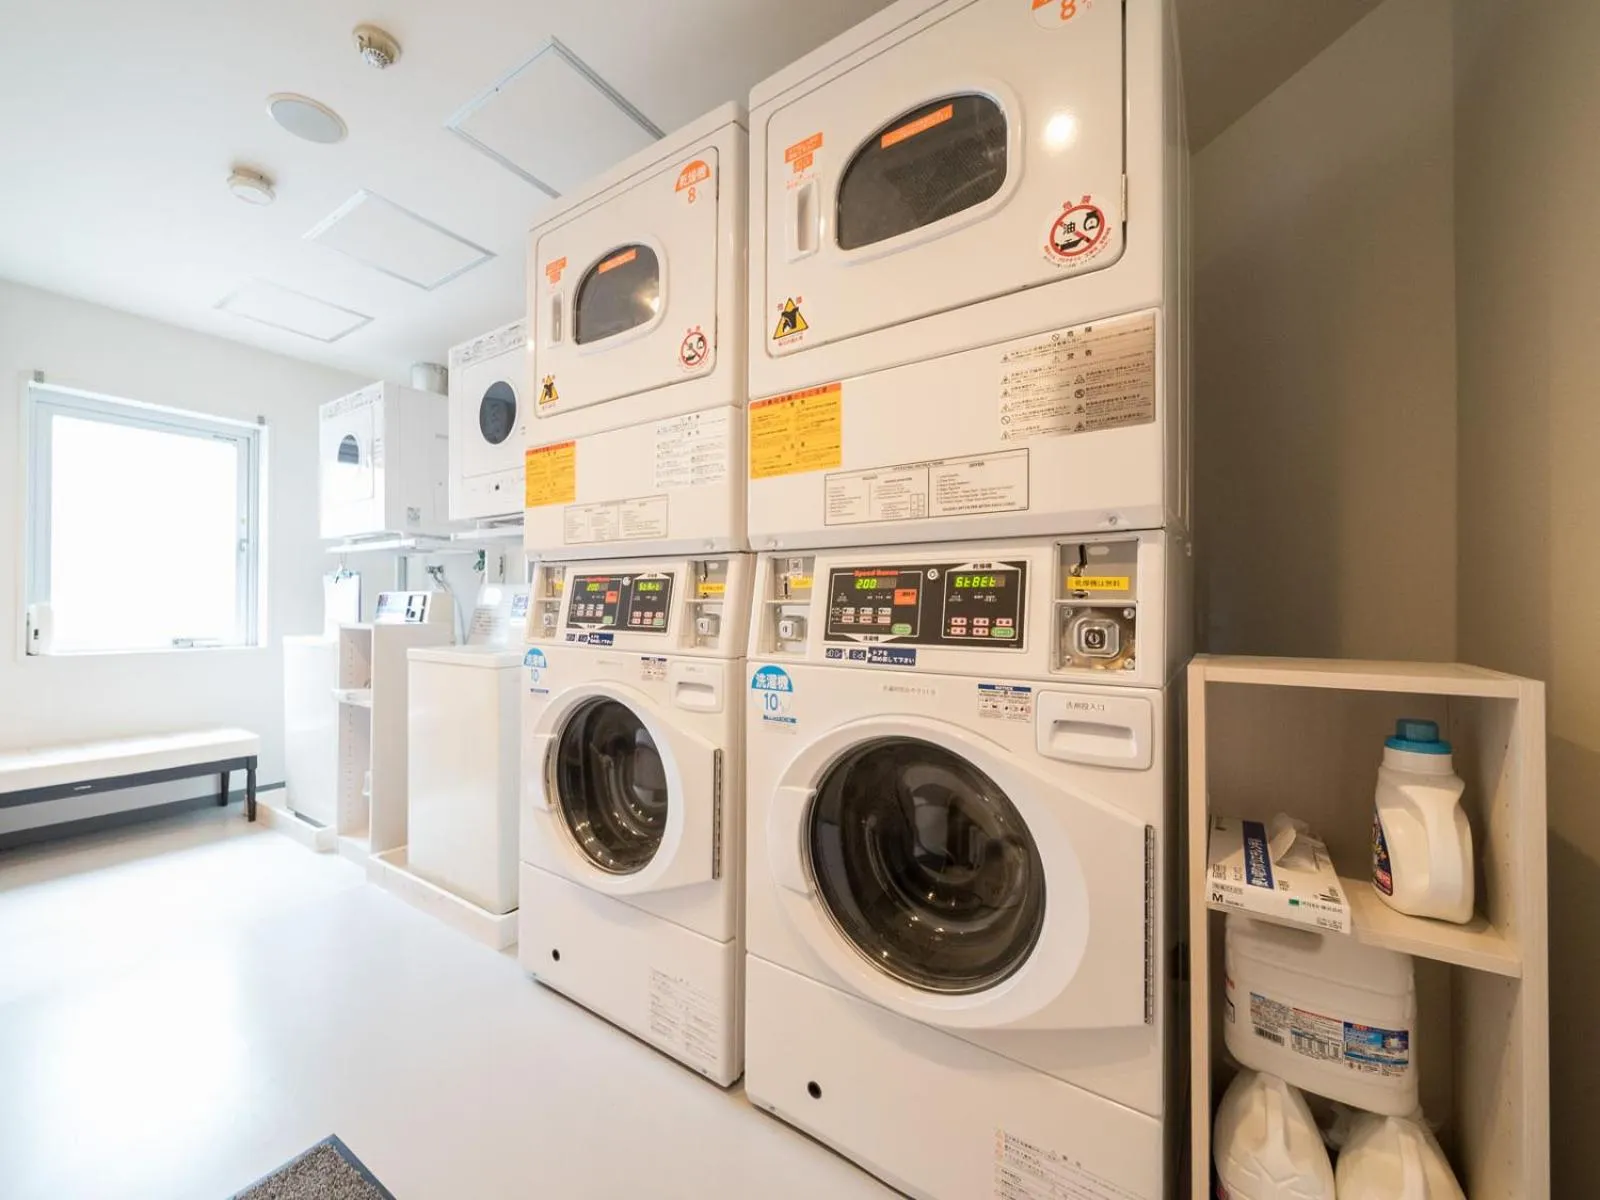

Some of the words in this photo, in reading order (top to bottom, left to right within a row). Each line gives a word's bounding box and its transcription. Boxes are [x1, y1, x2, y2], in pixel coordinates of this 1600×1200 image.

[687, 186, 697, 204] 8
[1063, 221, 1076, 235] 油
[855, 578, 877, 589] 200
[756, 673, 789, 690] 洗濯機
[764, 692, 778, 711] 10
[1212, 892, 1224, 903] M
